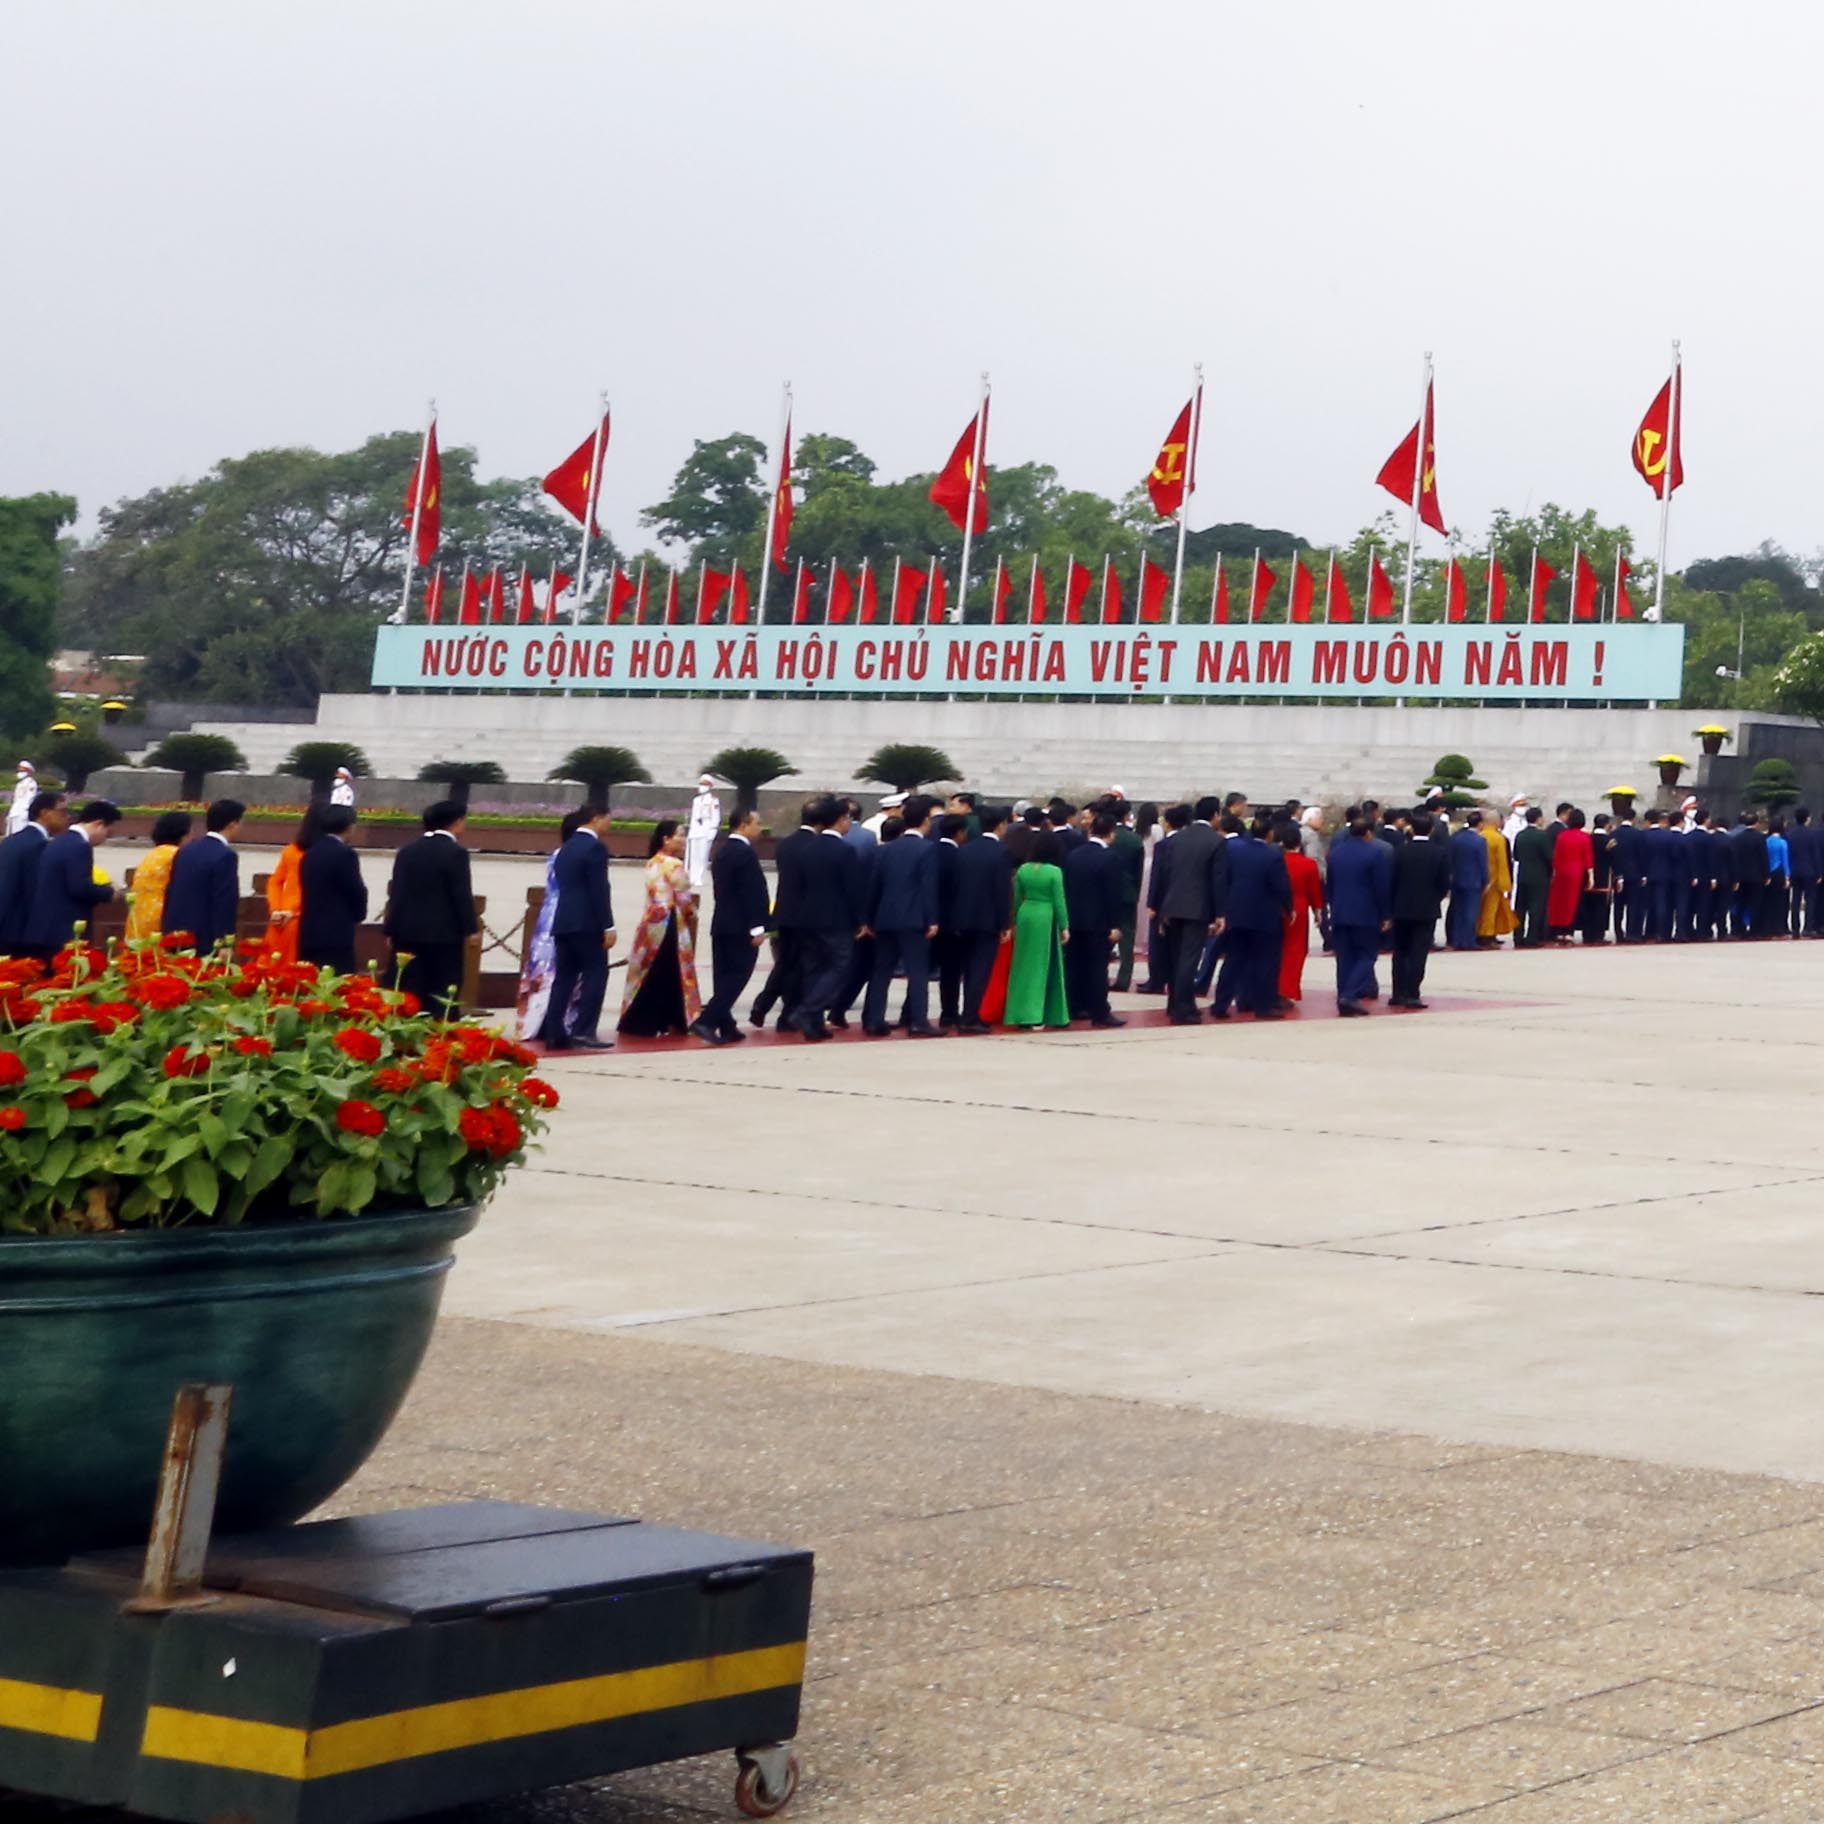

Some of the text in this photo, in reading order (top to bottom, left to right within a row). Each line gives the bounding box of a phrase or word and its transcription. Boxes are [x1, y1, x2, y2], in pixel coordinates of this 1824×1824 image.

[421, 631, 509, 677] NƯỚC
[523, 631, 615, 685] CỘNG
[628, 631, 697, 679] HÒA
[712, 631, 758, 680] XÃ
[775, 631, 838, 688] HỘI
[854, 628, 930, 681] CHỦ
[945, 631, 1066, 682] NGHĨA
[1090, 631, 1178, 691] VIỆT
[1196, 640, 1292, 684] NAM
[1311, 631, 1443, 685] MUÔN
[1463, 631, 1569, 686] NĂM
